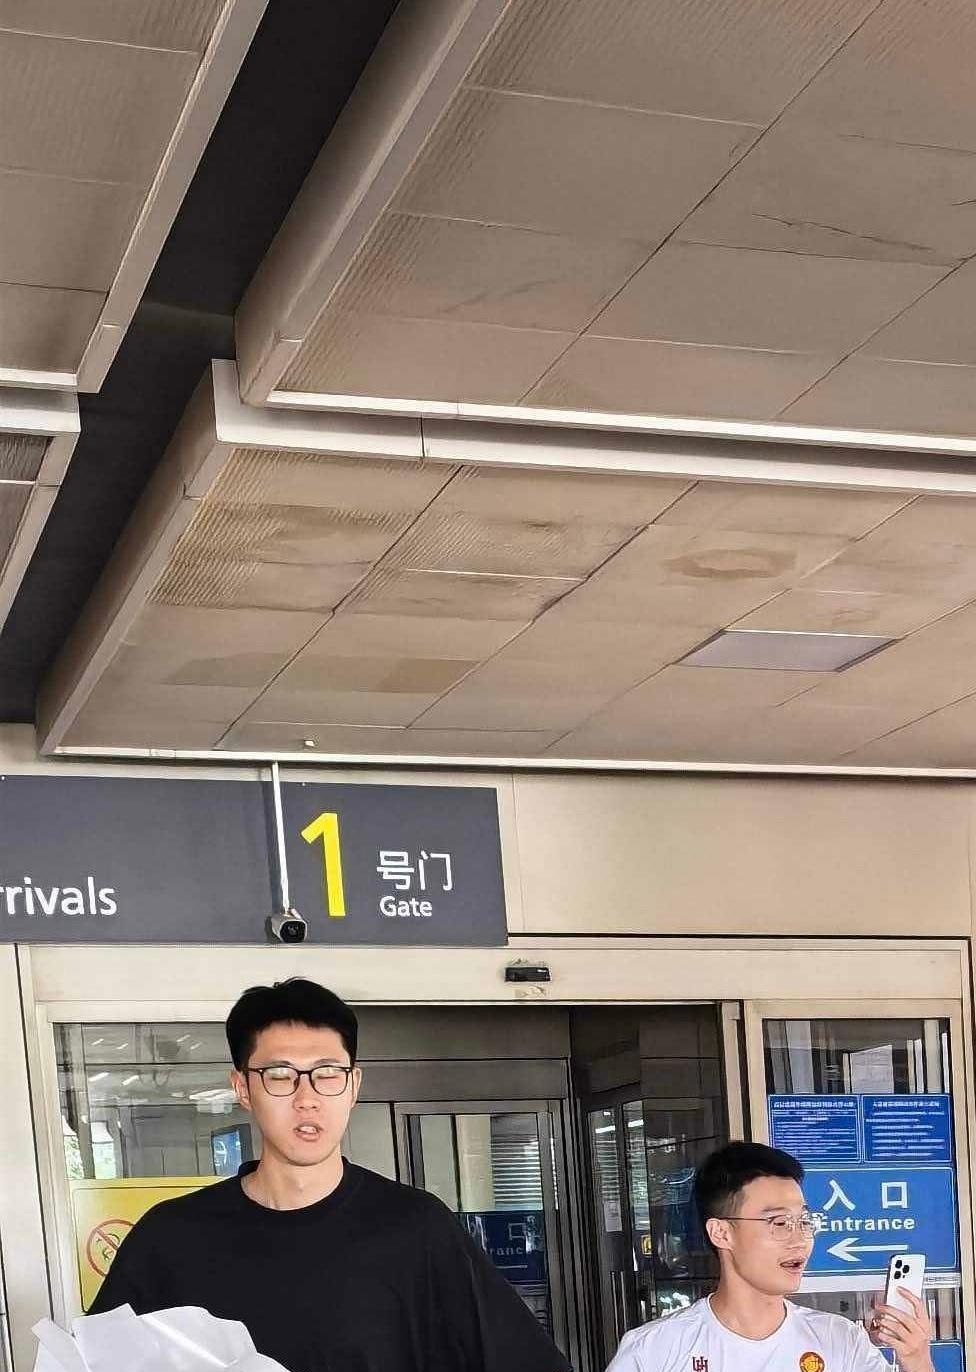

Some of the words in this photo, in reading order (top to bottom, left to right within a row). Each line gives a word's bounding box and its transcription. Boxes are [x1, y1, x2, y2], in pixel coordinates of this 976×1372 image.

[301, 812, 346, 917] 1
[376, 850, 453, 891] 号门
[379, 895, 433, 918] Gate
[823, 1179, 908, 1211] 入口
[817, 1216, 915, 1232] Entrance
